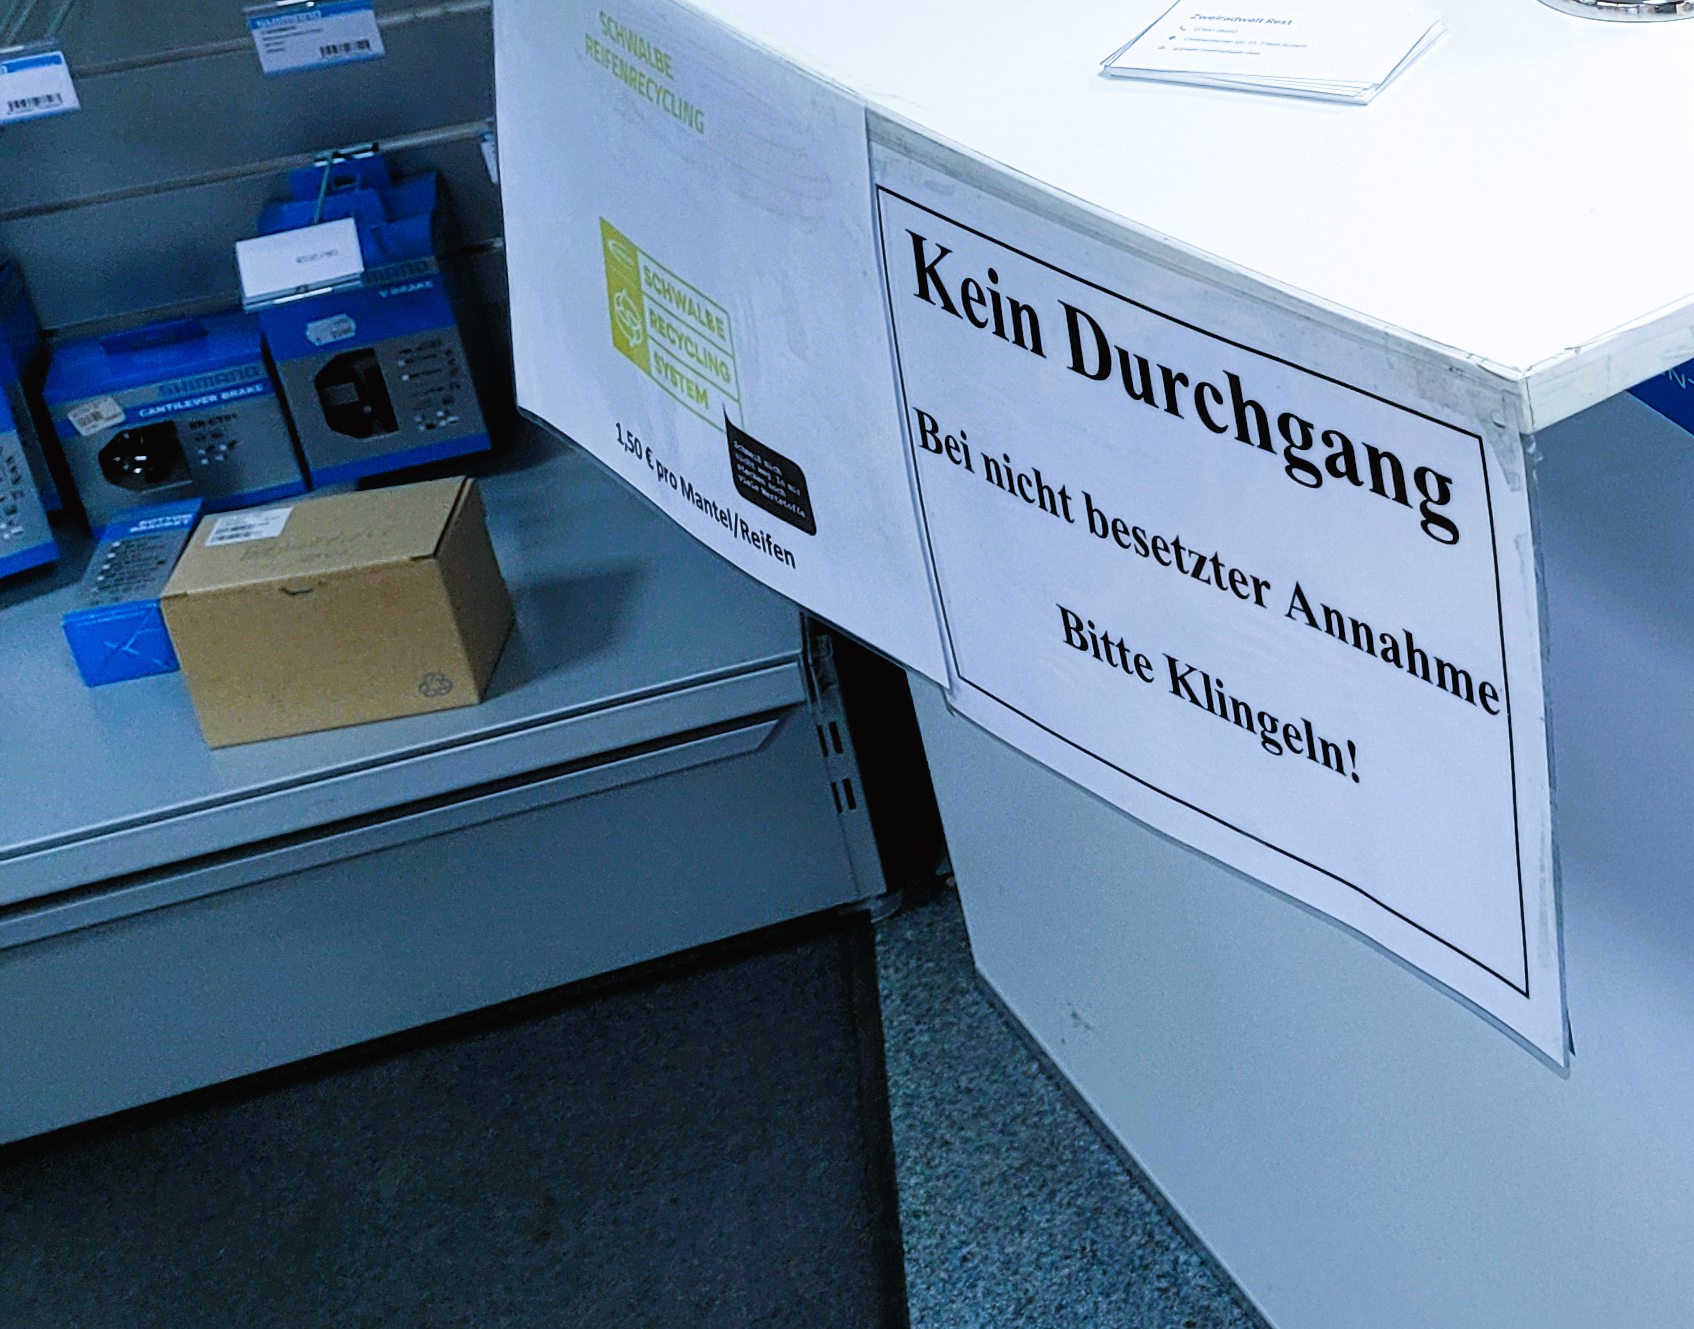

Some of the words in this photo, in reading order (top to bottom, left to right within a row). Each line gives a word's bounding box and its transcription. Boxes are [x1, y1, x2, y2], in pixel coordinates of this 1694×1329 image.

[599, 11, 675, 81] SCHWALBE
[1266, 17, 1293, 26] Rest
[584, 32, 705, 135] REIFENRECYCLING
[644, 264, 726, 342] SCHWALBE
[649, 306, 731, 384] RECYCLING
[653, 350, 710, 411] SYSTEM
[138, 395, 219, 418] CANTILEVER
[220, 383, 265, 401] BRAKE
[904, 227, 1048, 360] Kein
[1057, 298, 1461, 547] Durchgang
[615, 422, 643, 460] 1,50
[645, 446, 654, 471] €
[656, 459, 678, 491] pro
[680, 475, 797, 570] Mantel/Reifen
[913, 406, 977, 475] Bei
[983, 453, 1076, 525] nicht
[1083, 490, 1272, 609] besetzter
[1285, 580, 1502, 717] Annahme
[1055, 603, 1155, 684] Bitte
[1161, 651, 1361, 785] Klingeln!
